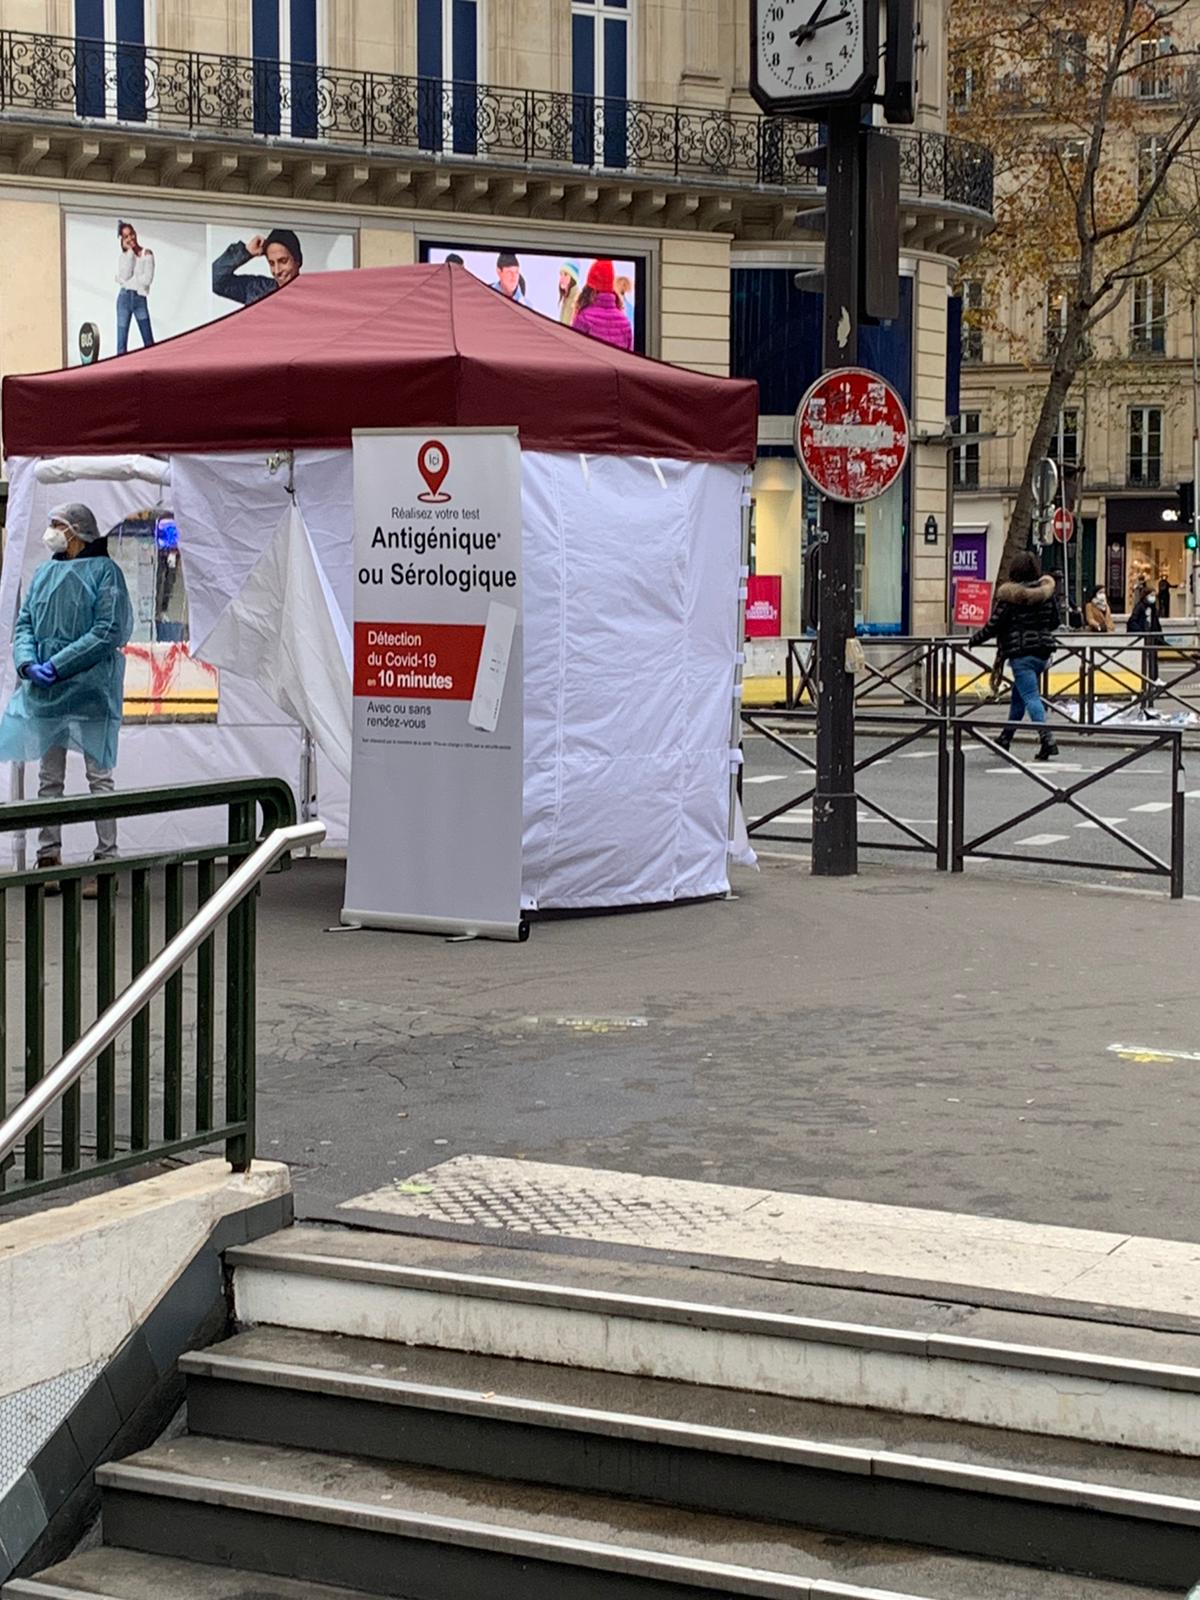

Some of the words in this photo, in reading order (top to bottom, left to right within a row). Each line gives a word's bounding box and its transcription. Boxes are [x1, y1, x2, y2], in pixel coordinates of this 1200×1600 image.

[771, 7, 784, 22] 10
[845, 21, 854, 36] 3
[766, 31, 775, 45] 9
[772, 52, 780, 67] 8
[839, 45, 848, 59] 4
[787, 66, 795, 82] 7
[824, 62, 834, 77] 5
[805, 71, 814, 86] 6
[81, 332, 93, 348] BUS
[428, 454, 440, 466] Ici
[391, 506, 433, 520] Réalisez
[435, 509, 459, 520] votre
[461, 508, 480, 520] test
[358, 567, 384, 585] ou
[391, 562, 517, 593] Sérologique
[367, 630, 423, 647] Détection
[367, 652, 383, 666] du
[385, 651, 437, 668] Covid-19
[378, 669, 395, 687] 10
[397, 670, 454, 690] minutes
[367, 701, 391, 714] Avec
[393, 705, 406, 715] ou
[408, 705, 432, 716] sans
[366, 716, 427, 729] rendez-vous
